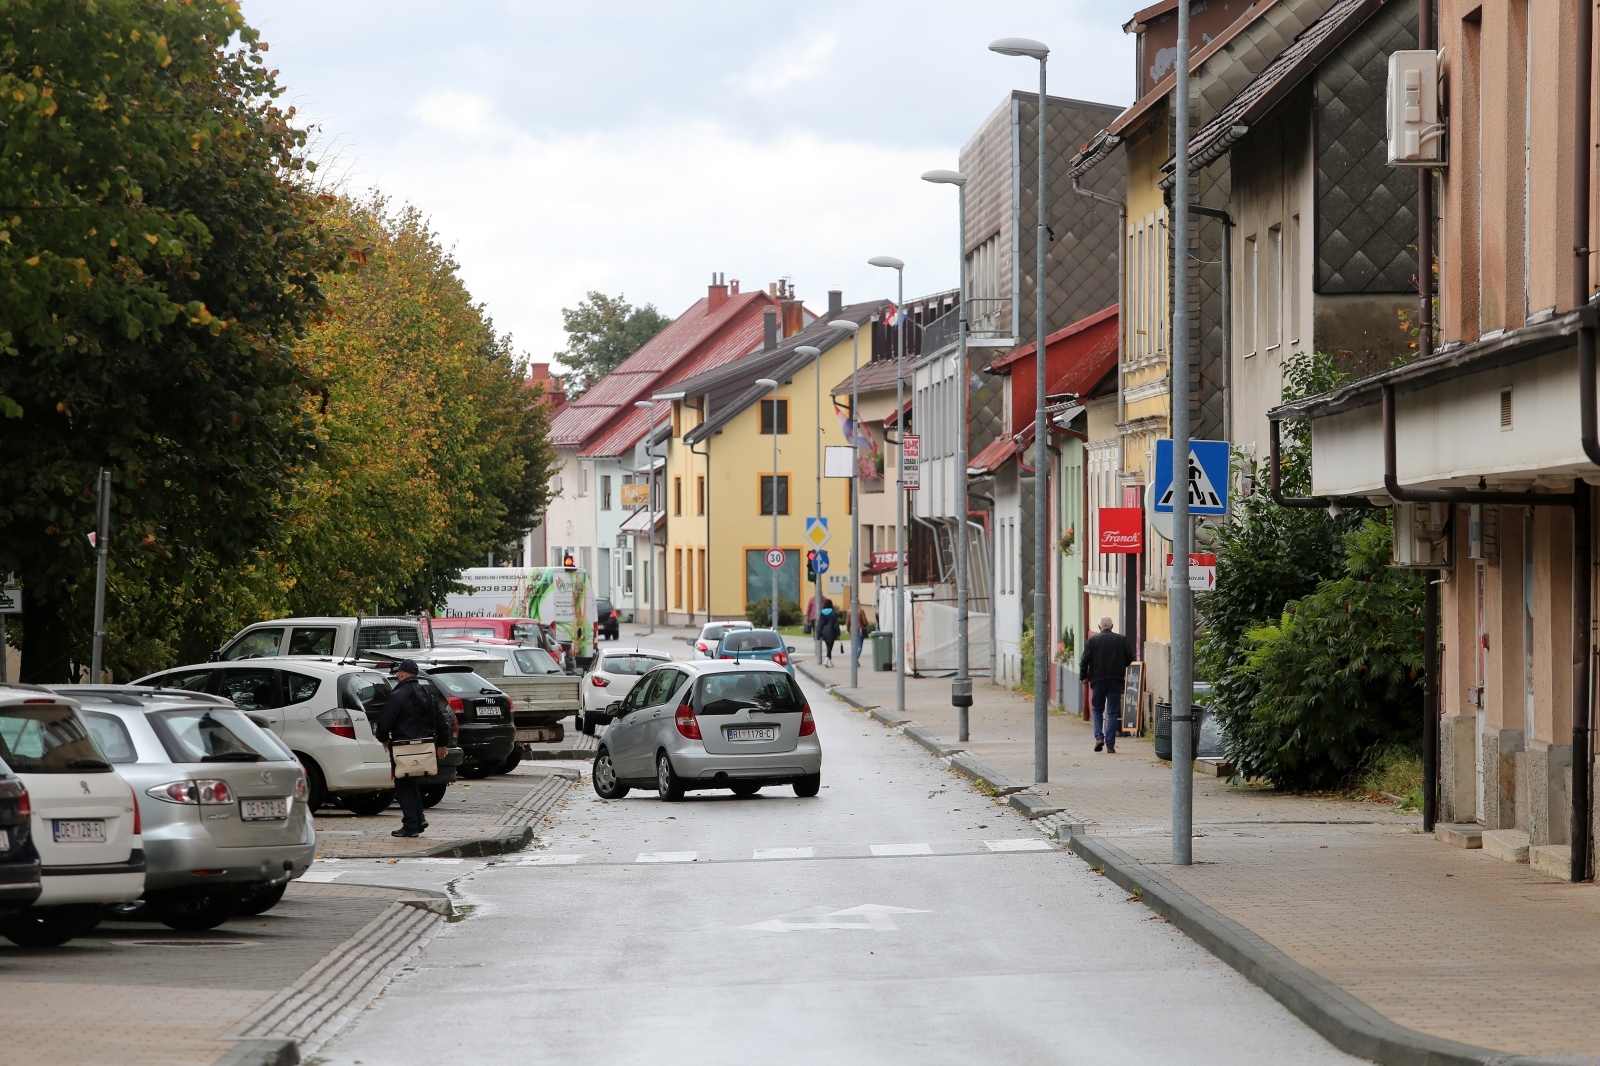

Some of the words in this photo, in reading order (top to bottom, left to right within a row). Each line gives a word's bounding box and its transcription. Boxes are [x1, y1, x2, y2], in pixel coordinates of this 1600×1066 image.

[1101, 530, 1140, 542] Franck
[770, 554, 780, 562] 30
[875, 553, 908, 563] TISAK
[446, 608, 462, 618] Eko
[247, 802, 256, 815] DE
[61, 823, 70, 837] DE
[77, 823, 104, 837] 128-FL
